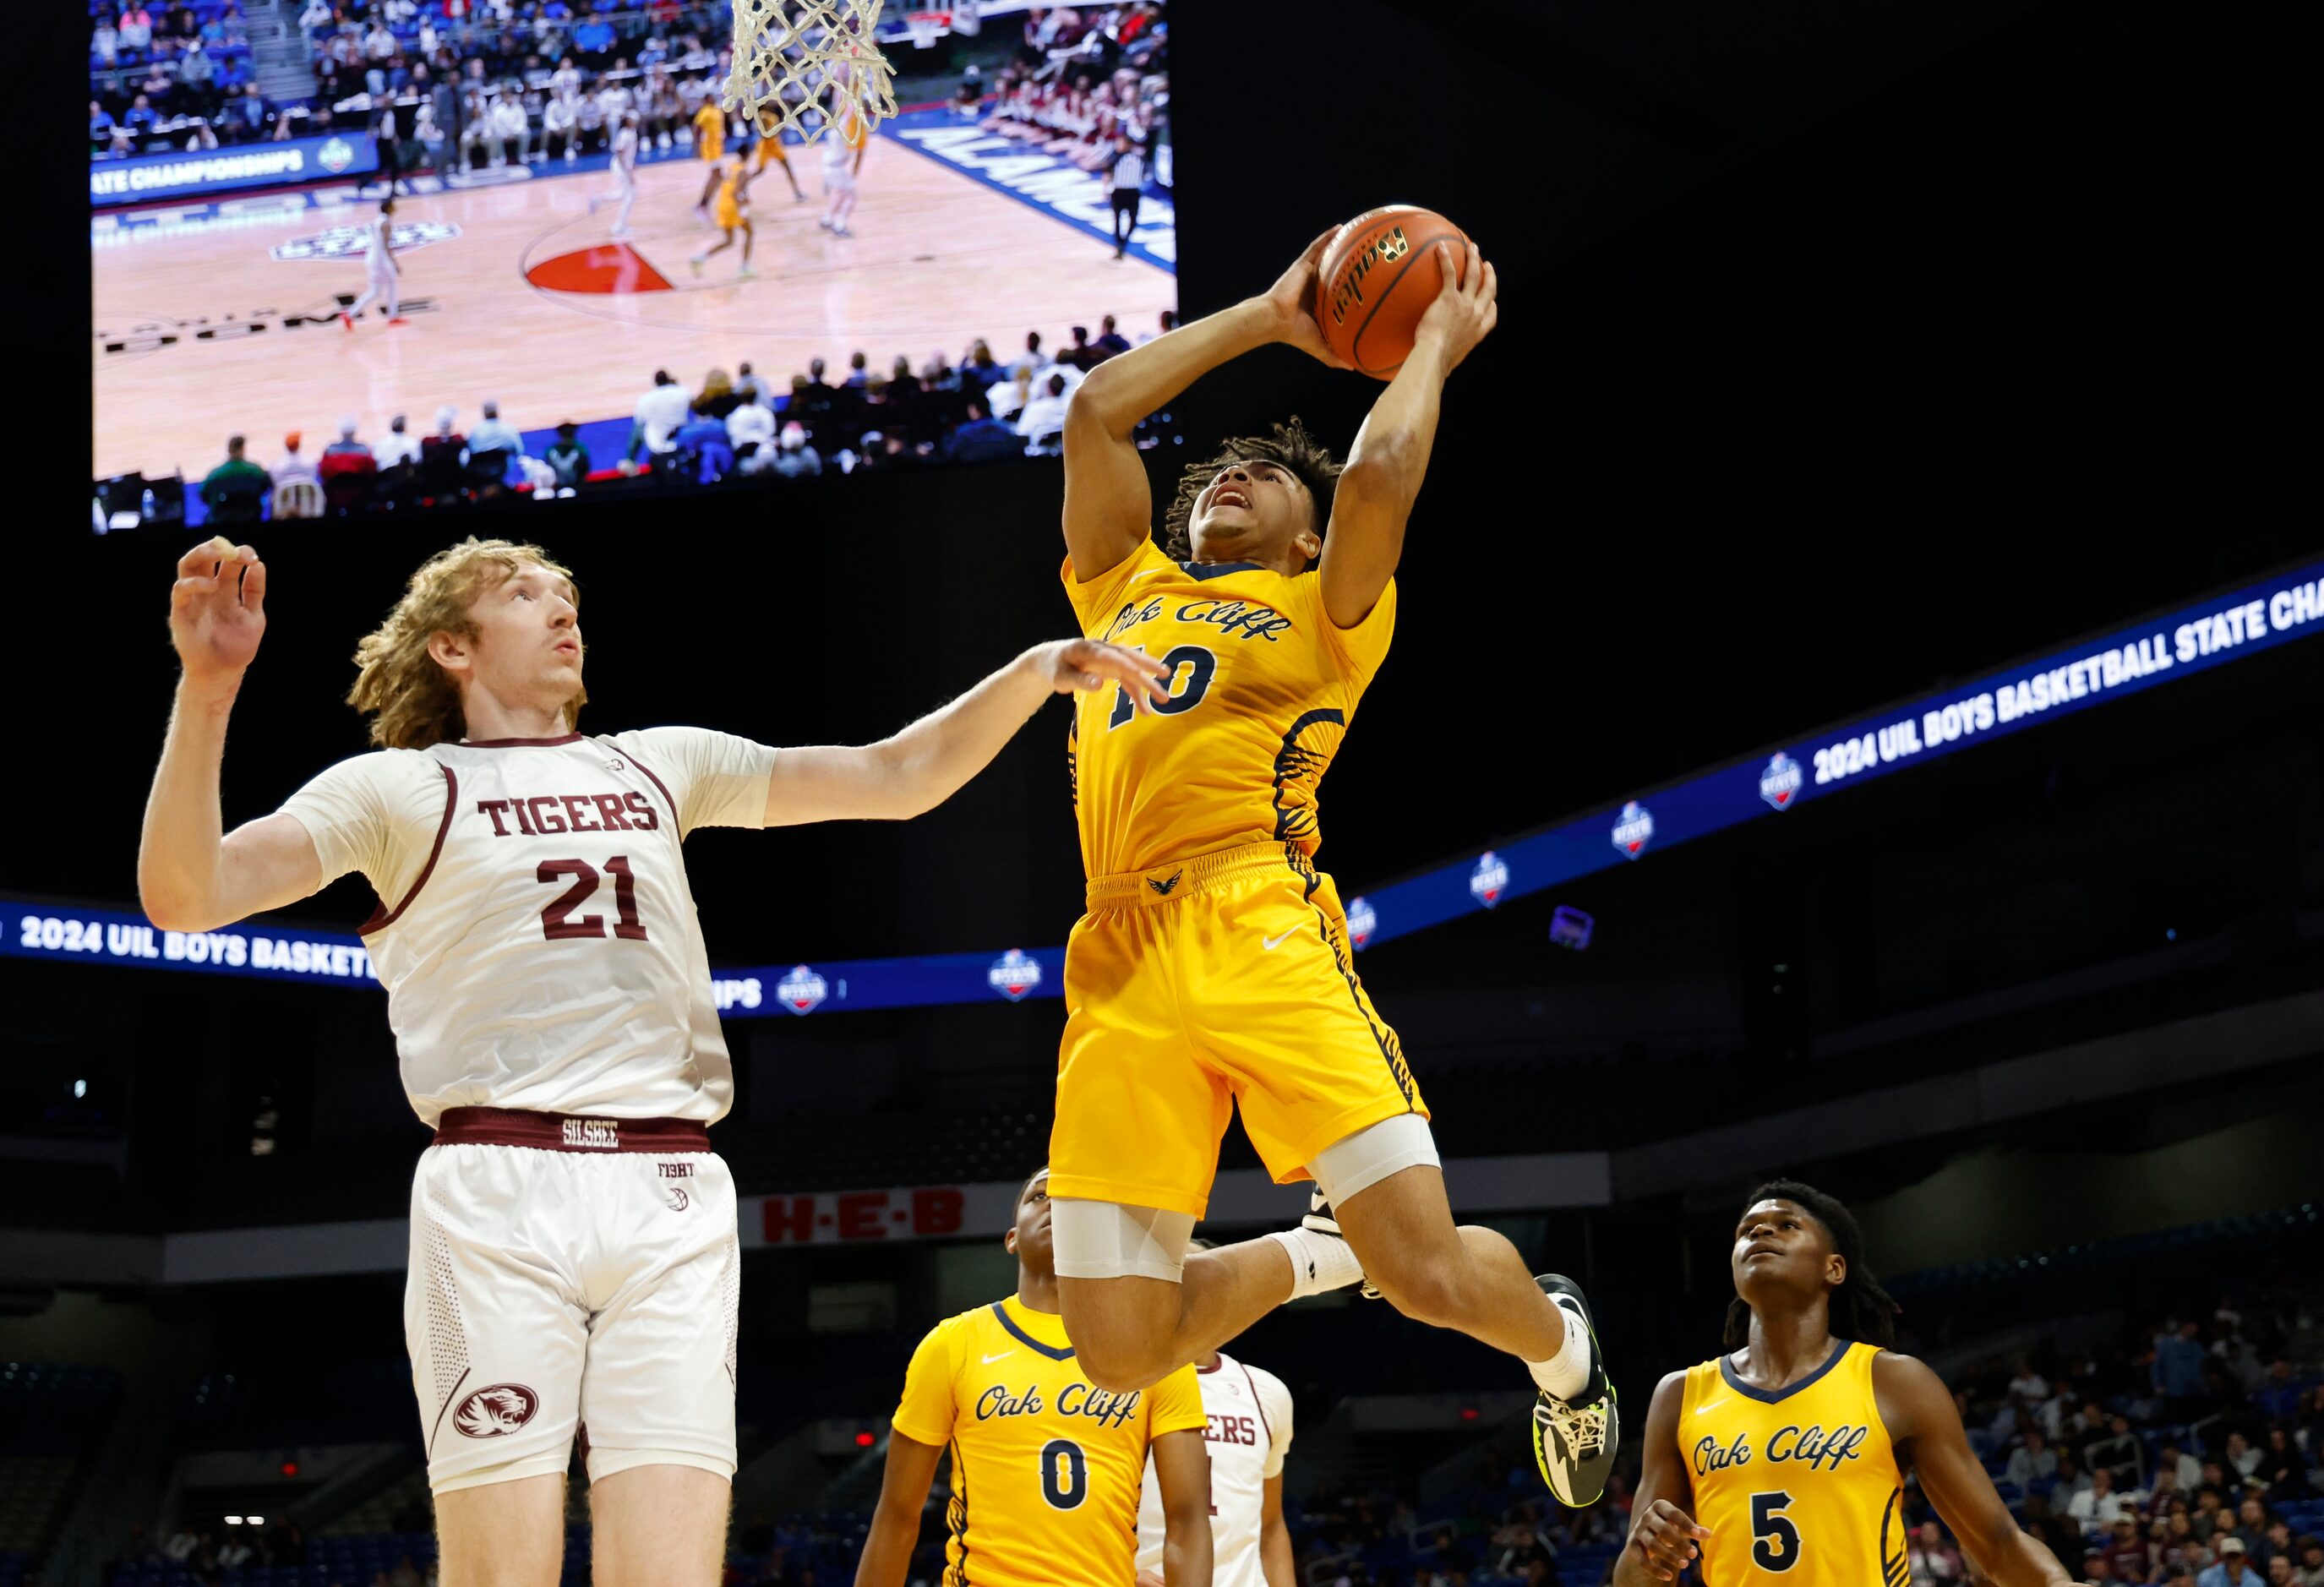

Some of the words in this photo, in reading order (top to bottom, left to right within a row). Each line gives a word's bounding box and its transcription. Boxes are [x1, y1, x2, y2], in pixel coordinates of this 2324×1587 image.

[129, 149, 303, 190] CHAMPIONSHIPS
[1104, 597, 1165, 642] Oak
[1176, 600, 1292, 641] Cliff
[1814, 732, 1878, 784] 2024
[1878, 719, 1923, 762] UIL
[1923, 692, 1995, 748] BOYS
[1996, 633, 2174, 723] BASKETBALL
[2174, 598, 2267, 663] STATE
[477, 791, 658, 837] TIGERS
[537, 855, 649, 941] 21
[20, 915, 103, 953] 2024
[107, 923, 159, 958] UIL
[163, 930, 248, 967] BOYS
[563, 1119, 619, 1148] SILSBEE
[976, 1384, 1043, 1421] Oak
[1057, 1383, 1141, 1428] Cliff
[1039, 1437, 1089, 1512] 0
[1694, 1432, 1752, 1476] Oak
[1766, 1425, 1867, 1470] Cliff
[1749, 1490, 1803, 1573] 5
